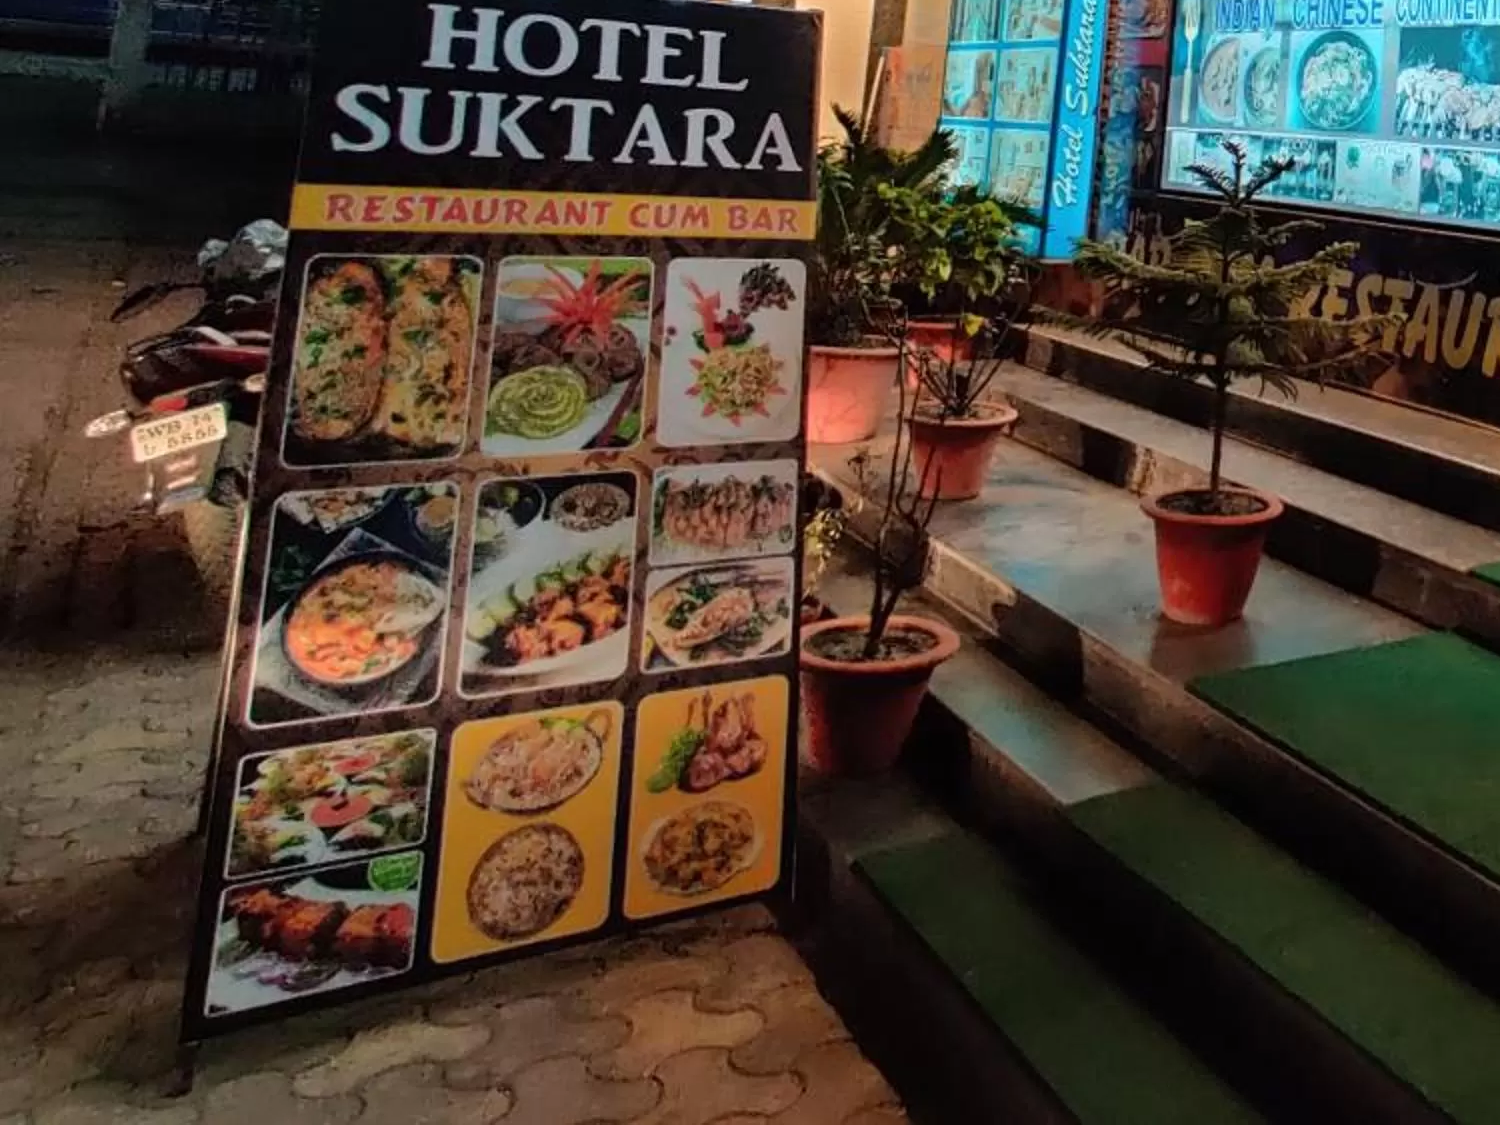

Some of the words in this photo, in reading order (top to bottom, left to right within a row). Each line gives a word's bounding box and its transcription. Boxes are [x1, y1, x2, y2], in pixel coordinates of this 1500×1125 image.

[421, 2, 750, 93] HOTEL
[330, 83, 803, 173] SUKTARA
[1051, 124, 1084, 209] Hotel
[325, 192, 612, 230] RESTAURANT
[628, 200, 711, 231] CUM
[727, 205, 799, 233] BAR
